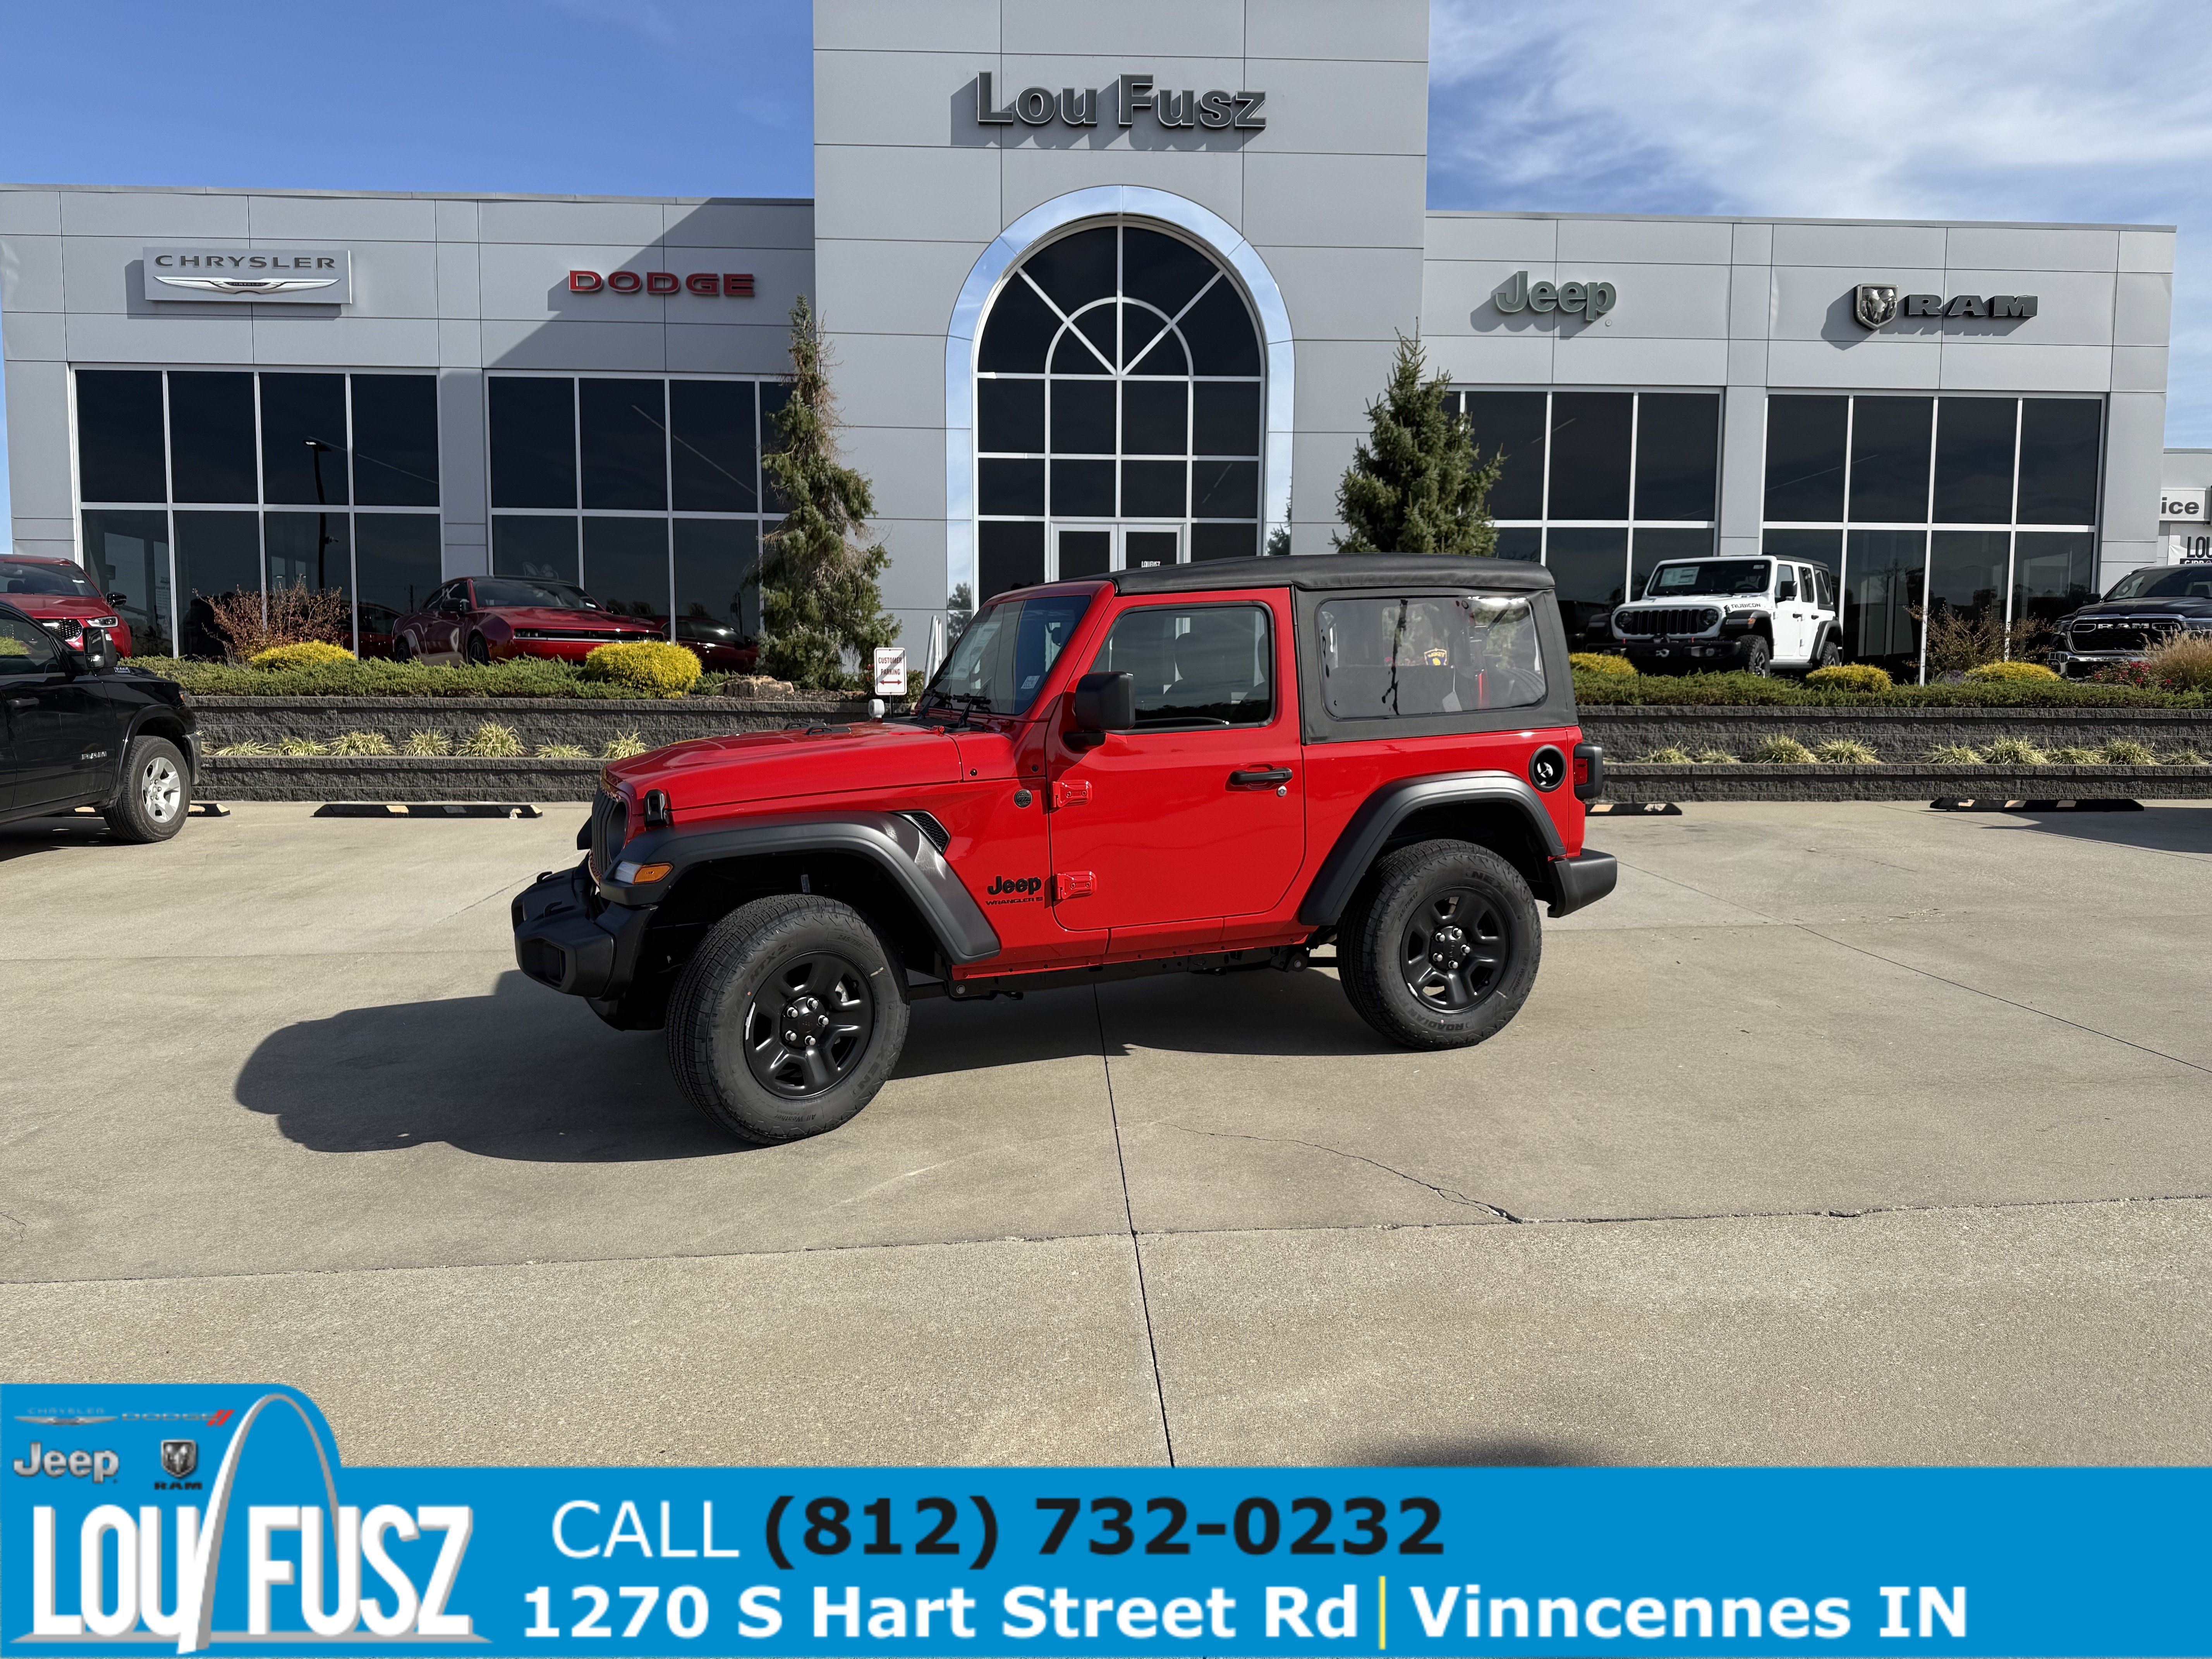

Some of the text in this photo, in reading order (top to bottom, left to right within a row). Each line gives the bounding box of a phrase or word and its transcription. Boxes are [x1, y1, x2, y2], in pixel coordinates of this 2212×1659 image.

[977, 71, 1267, 129] Lou Fusz
[155, 255, 336, 270] CHRYSLER
[569, 270, 754, 297] DODGE
[1496, 271, 1616, 322] Jeep
[1904, 294, 2038, 317] RAM
[82, 751, 107, 759] RAM
[988, 876, 1041, 895] Jeep
[985, 897, 1035, 905] WRANGLER
[837, 934, 870, 951] 245/75R17
